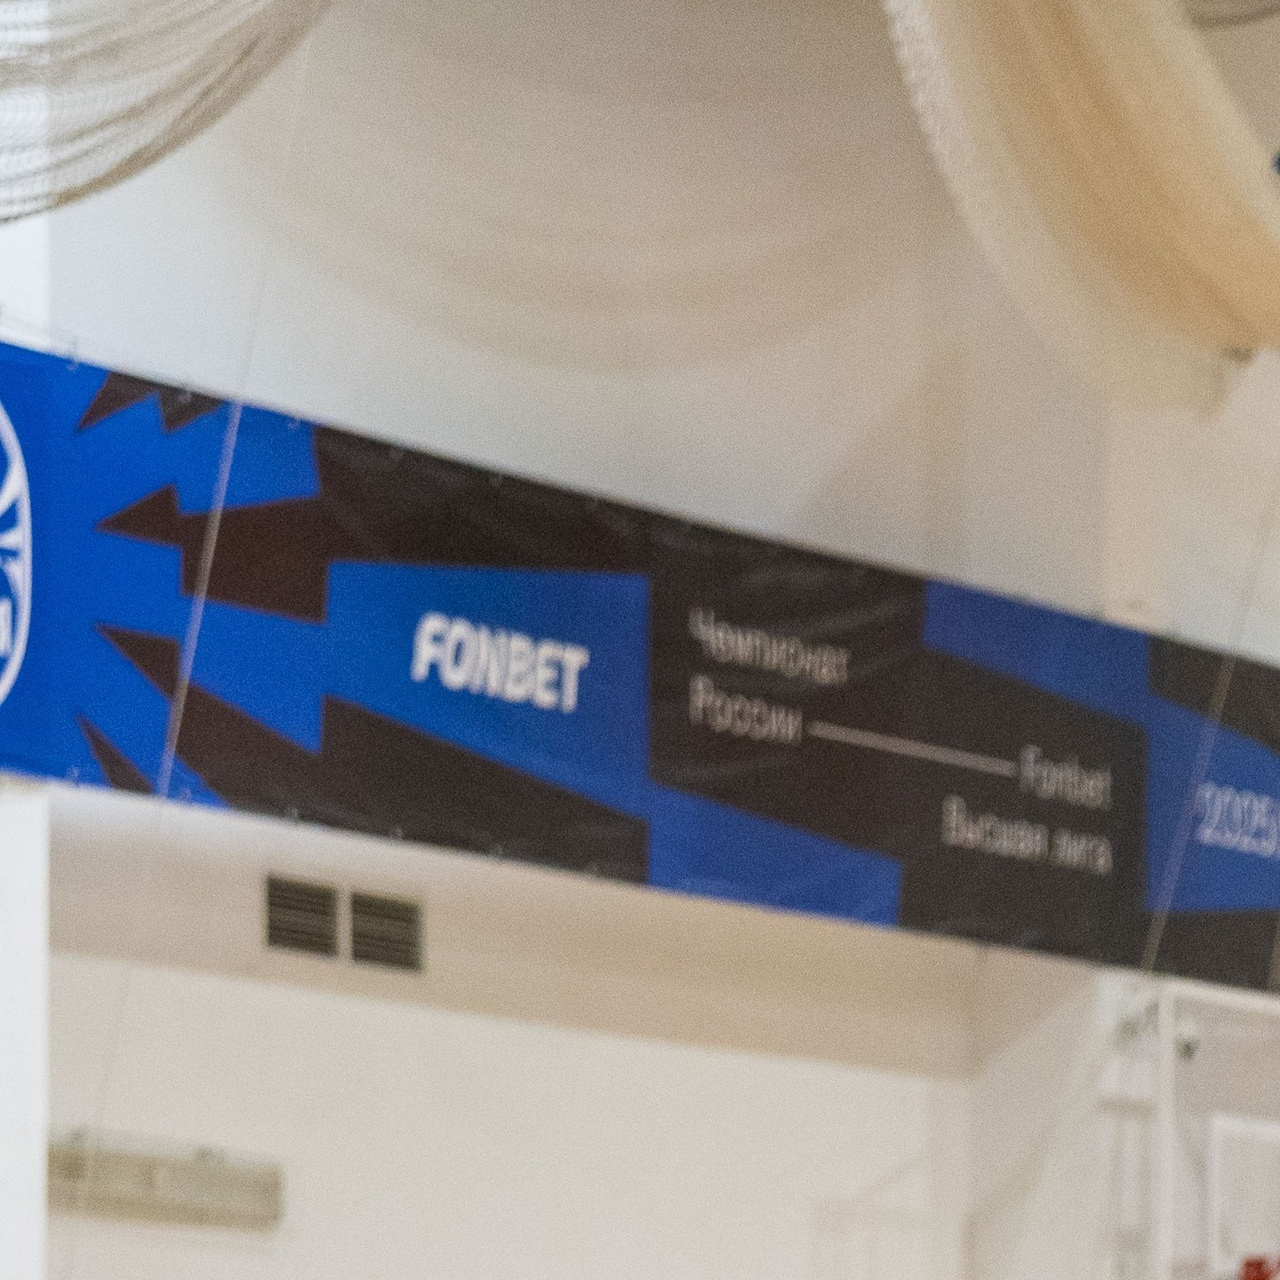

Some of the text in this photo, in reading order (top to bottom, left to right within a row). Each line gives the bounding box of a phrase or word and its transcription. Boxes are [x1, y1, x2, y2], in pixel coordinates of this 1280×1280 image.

[411, 611, 590, 714] FONBET
[688, 606, 849, 686] Чемпионат
[689, 673, 803, 743] России
